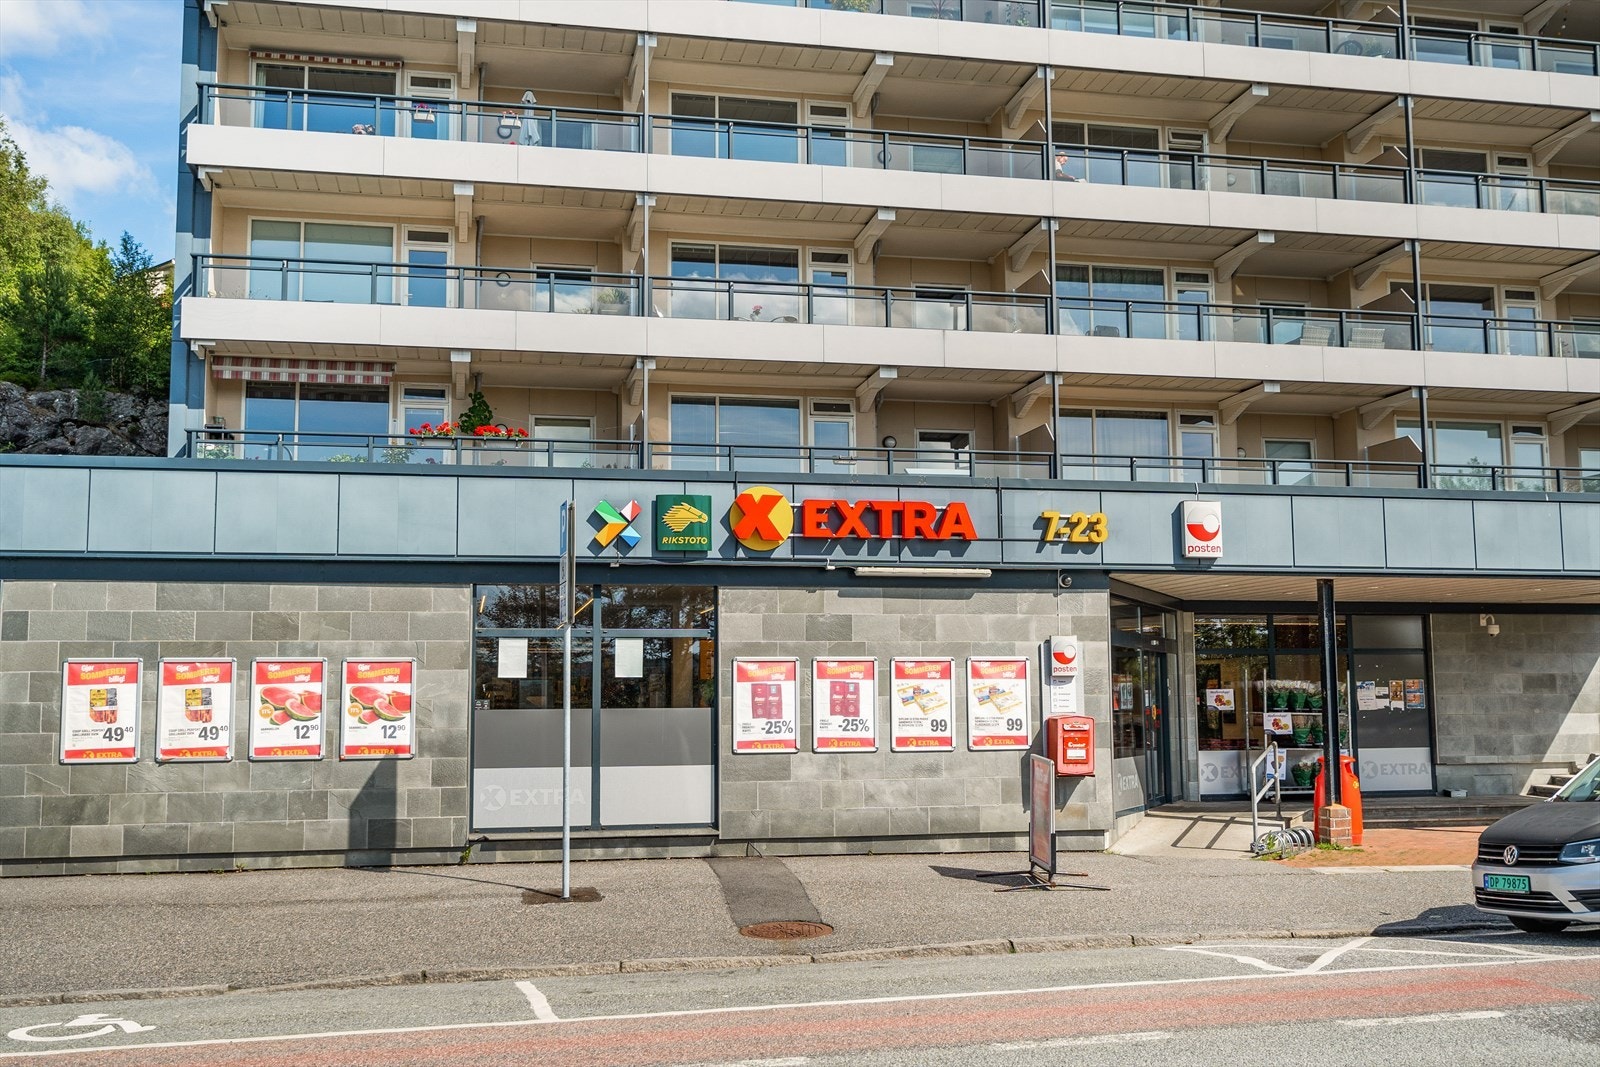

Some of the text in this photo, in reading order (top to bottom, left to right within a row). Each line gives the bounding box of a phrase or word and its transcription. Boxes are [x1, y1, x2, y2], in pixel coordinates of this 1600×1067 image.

[803, 499, 978, 540] EXTRA
[1041, 511, 1109, 543] 7-23
[662, 536, 708, 545] RIKSTOTO
[1187, 544, 1221, 554] posten
[81, 667, 126, 680] SOMMEREN
[176, 667, 220, 680] SOMMEREN
[268, 667, 311, 679] SOMMEREN
[357, 667, 400, 679] SOMMEREN
[827, 665, 864, 675] SOMMEREN
[905, 665, 942, 675] SOMMEREN
[761, 720, 793, 734] -25%
[838, 719, 870, 732] -25%
[931, 719, 947, 732] 99
[1006, 718, 1023, 731] 99
[103, 727, 124, 742] 49
[198, 726, 219, 741] 49
[294, 725, 310, 739] 12
[381, 725, 397, 739] 12
[1381, 763, 1429, 776] EXTRA
[1490, 877, 1527, 890] DP 79875
